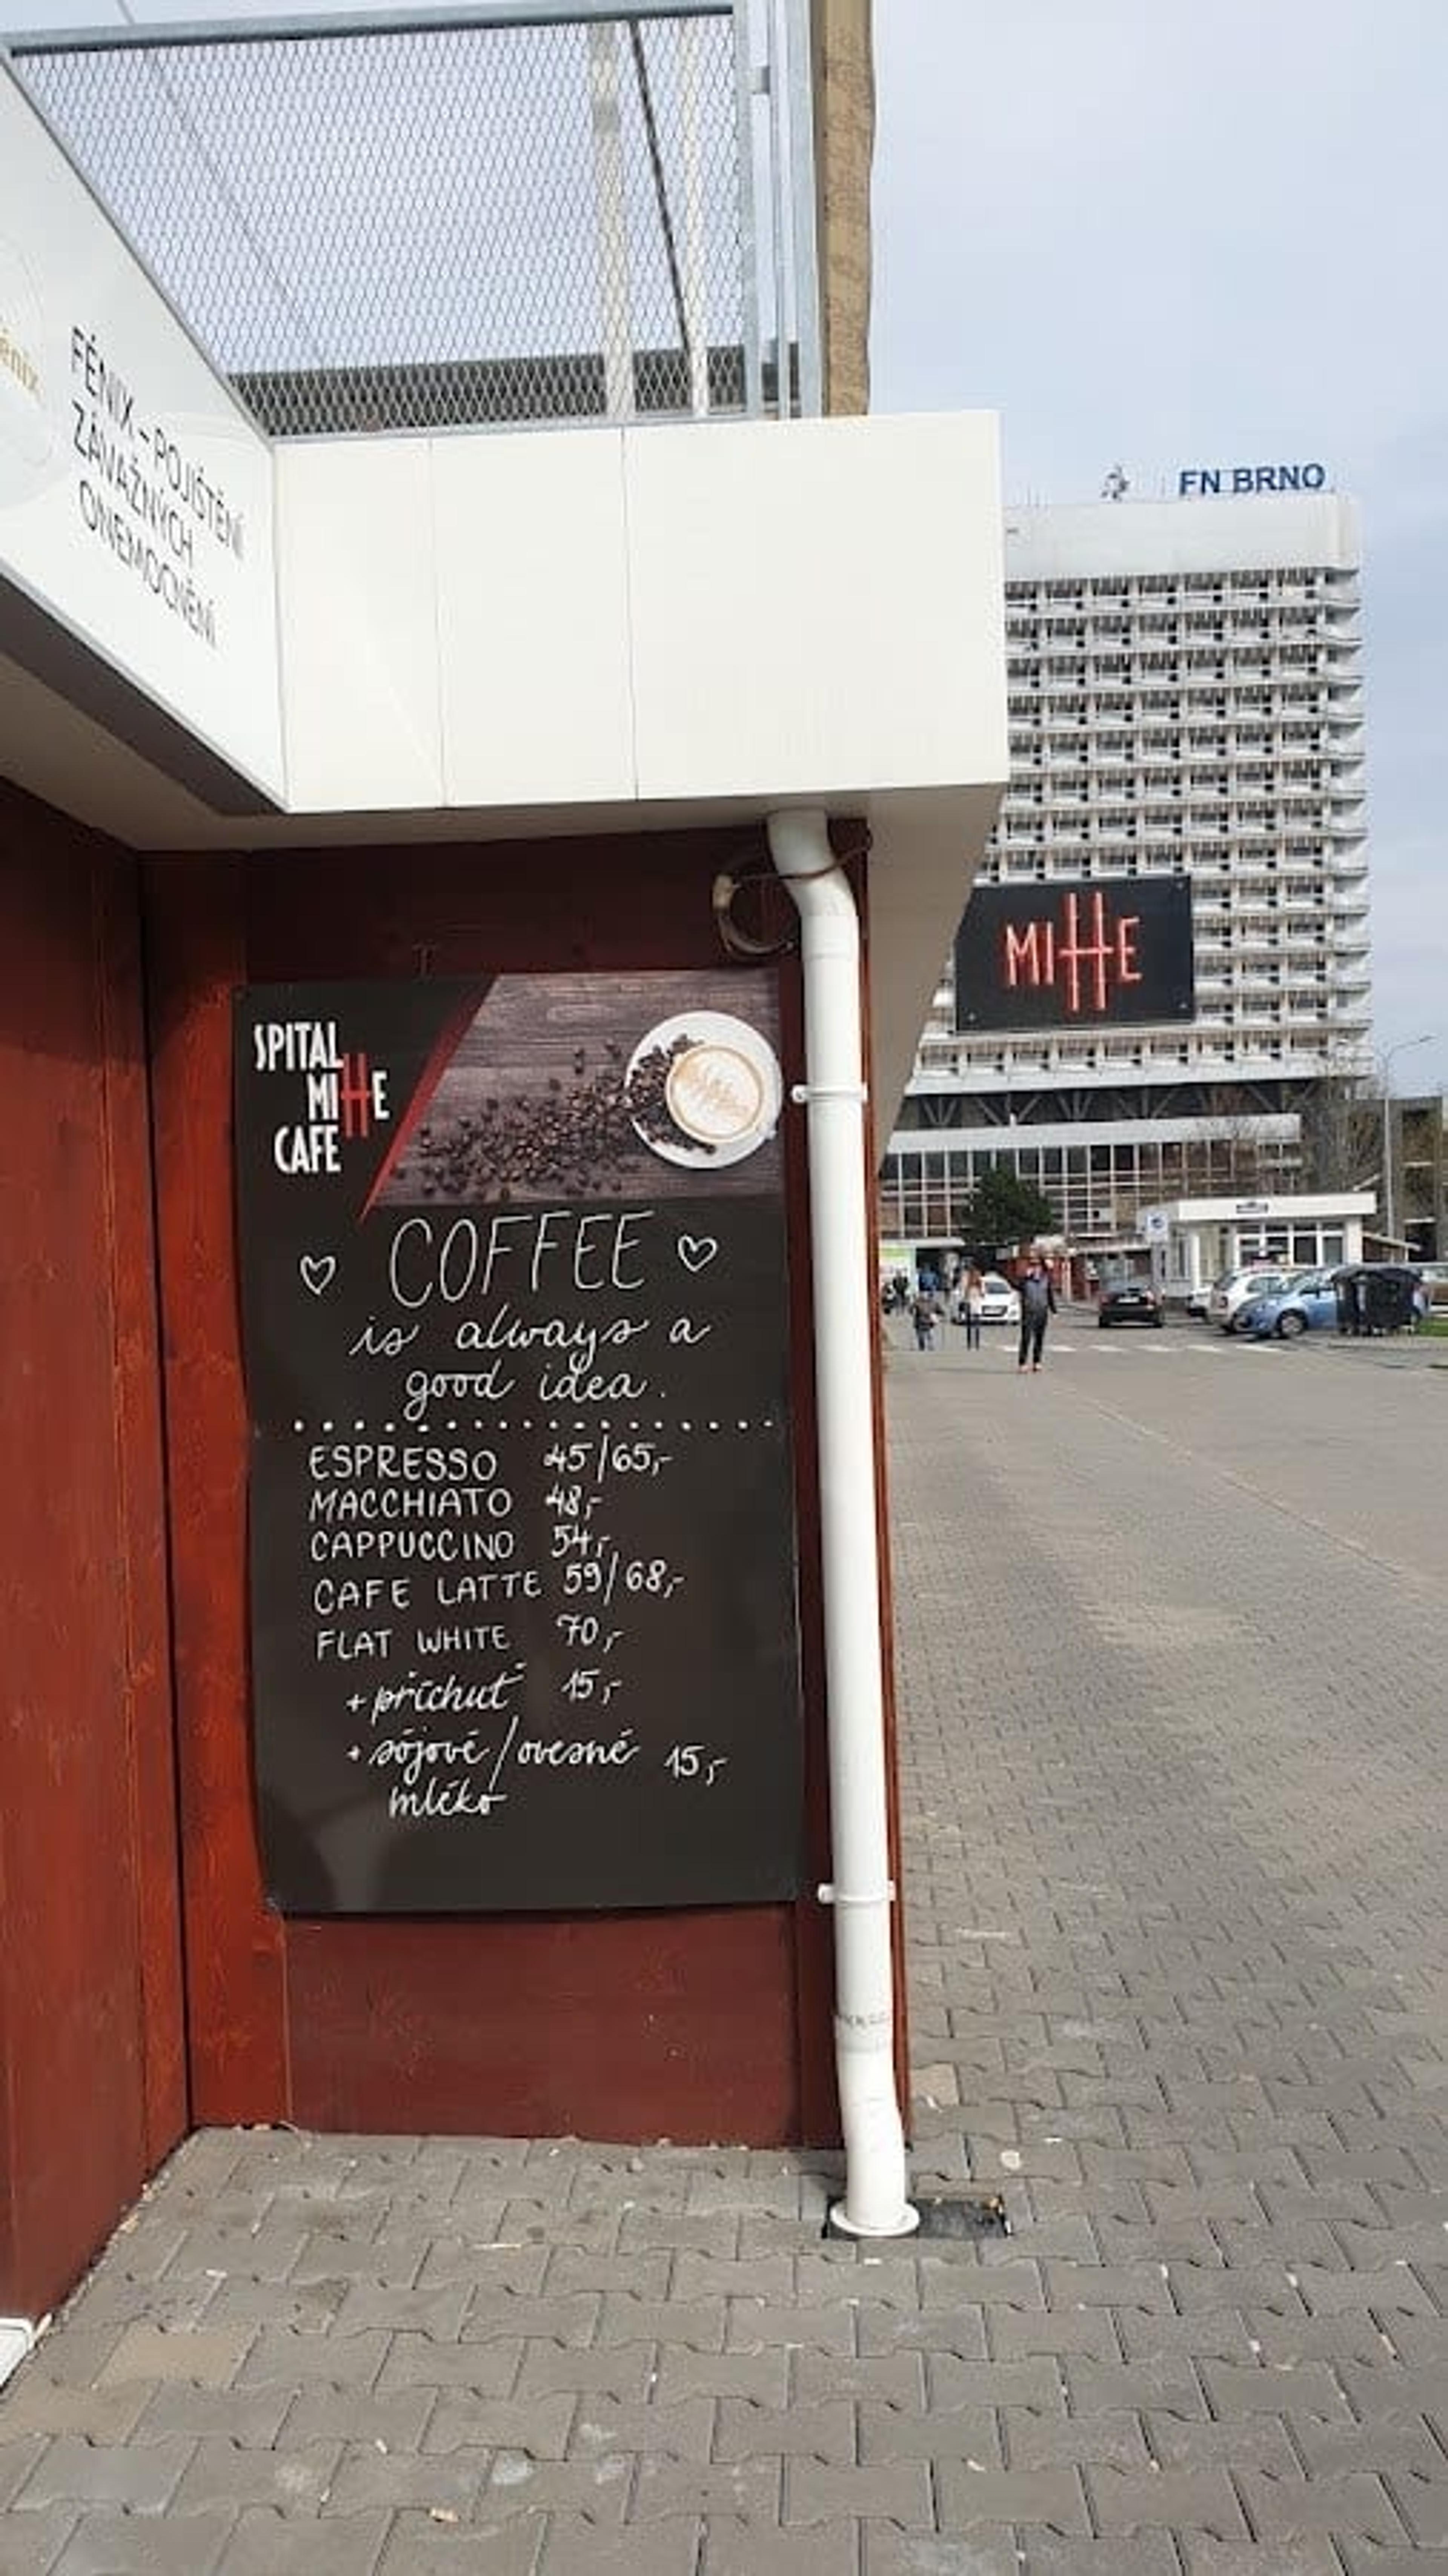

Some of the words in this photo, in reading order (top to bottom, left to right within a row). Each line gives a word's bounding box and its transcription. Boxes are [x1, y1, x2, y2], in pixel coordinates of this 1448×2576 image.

[72, 326, 133, 439] FÉNIX
[1179, 471, 1220, 496] FN
[1233, 464, 1325, 493] BRNO
[255, 1021, 344, 1071] SPITAL
[274, 1125, 341, 1174] CAFE
[390, 1210, 655, 1308] COFFEE
[349, 1316, 420, 1356] is
[456, 1303, 650, 1374] always
[669, 1317, 712, 1344] a
[403, 1358, 515, 1422] good
[309, 1444, 498, 1481] ESPRESSO
[309, 1487, 512, 1523] MACCHIATO
[310, 1529, 514, 1562] CAPPUCCINO
[314, 1578, 410, 1615] CAFE
[437, 1570, 542, 1605] LATTE
[317, 1629, 393, 1660] FLAT
[417, 1625, 511, 1654] WHITE
